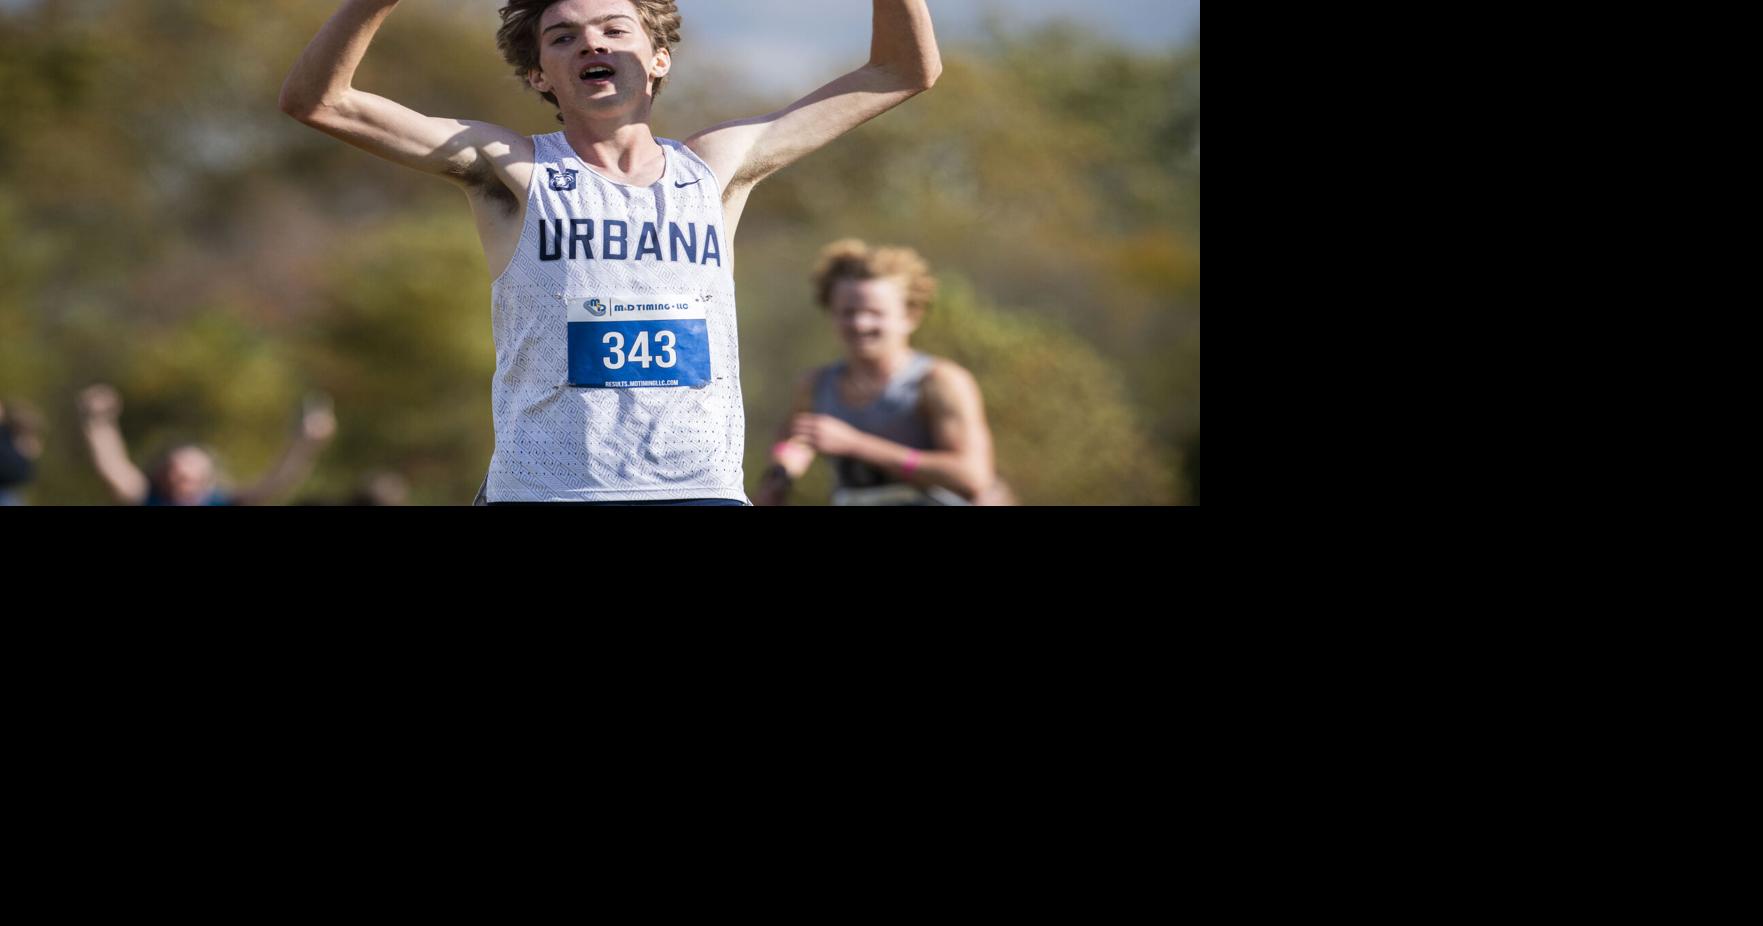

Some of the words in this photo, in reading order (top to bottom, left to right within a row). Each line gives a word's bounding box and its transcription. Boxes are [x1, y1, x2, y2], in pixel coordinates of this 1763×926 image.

[539, 218, 721, 267] URBANA
[637, 303, 671, 311] TIMING
[602, 330, 677, 370] 343
